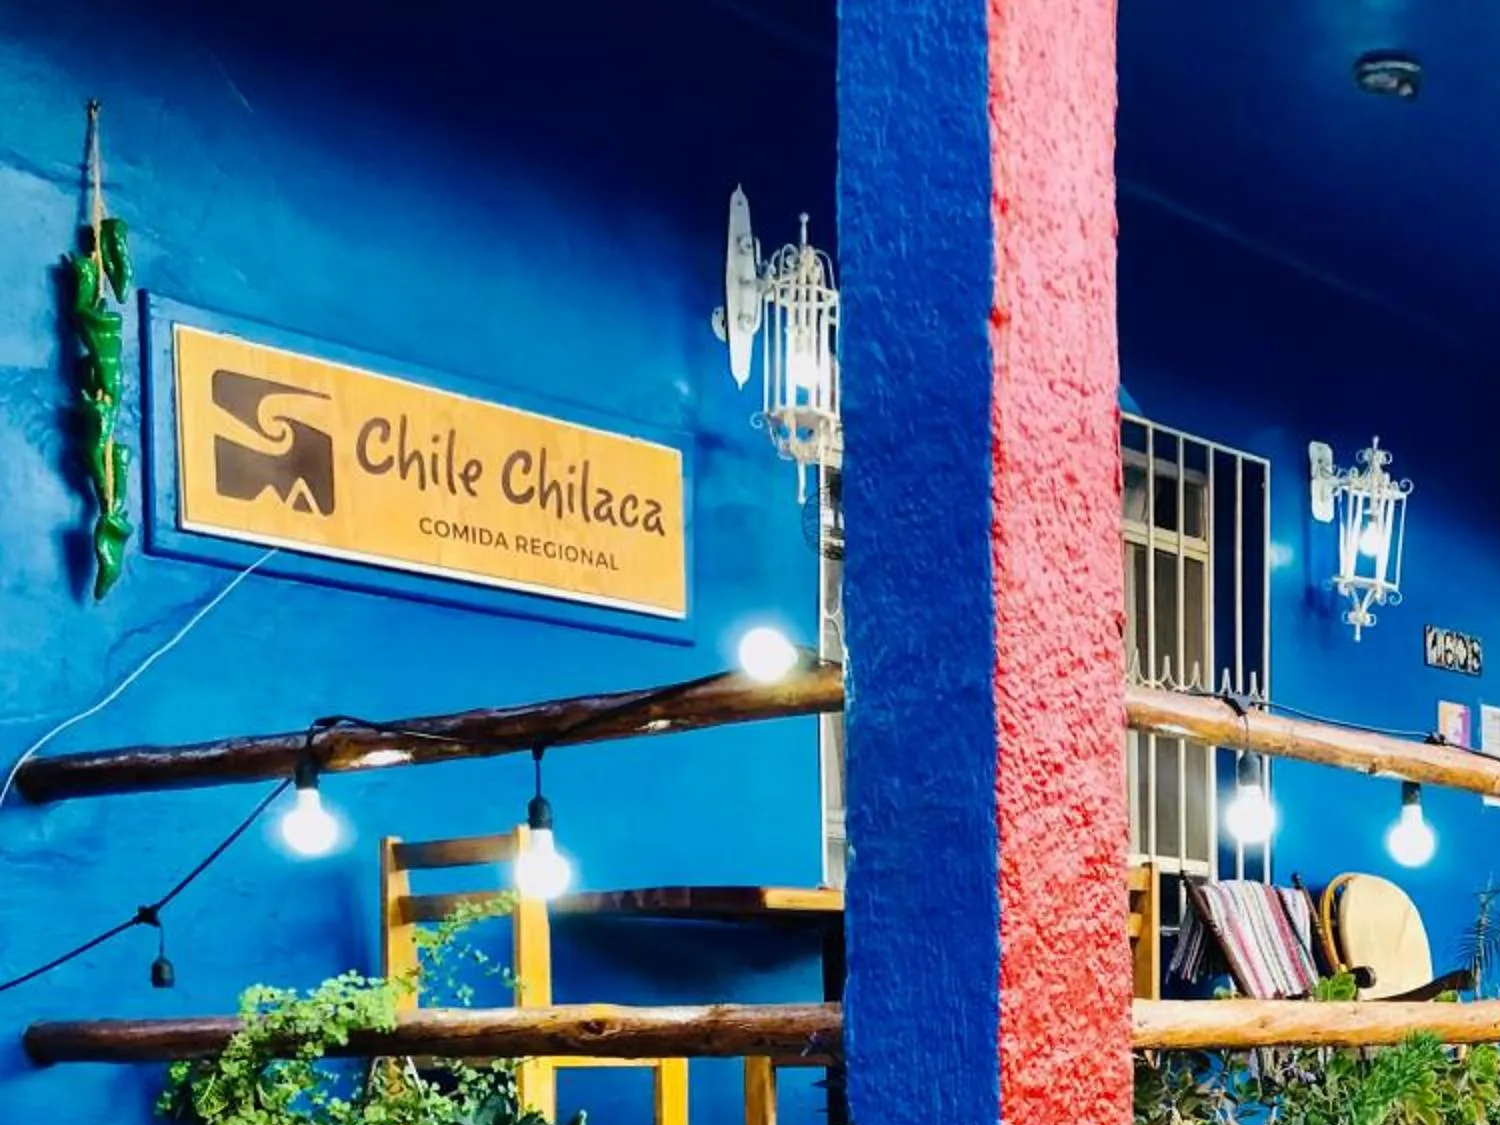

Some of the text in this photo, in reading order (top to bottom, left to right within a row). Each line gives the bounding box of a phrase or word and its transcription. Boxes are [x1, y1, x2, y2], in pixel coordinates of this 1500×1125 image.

[356, 414, 666, 537] Chile Chilaca
[418, 517, 620, 571] COMIDA REGIONAL
